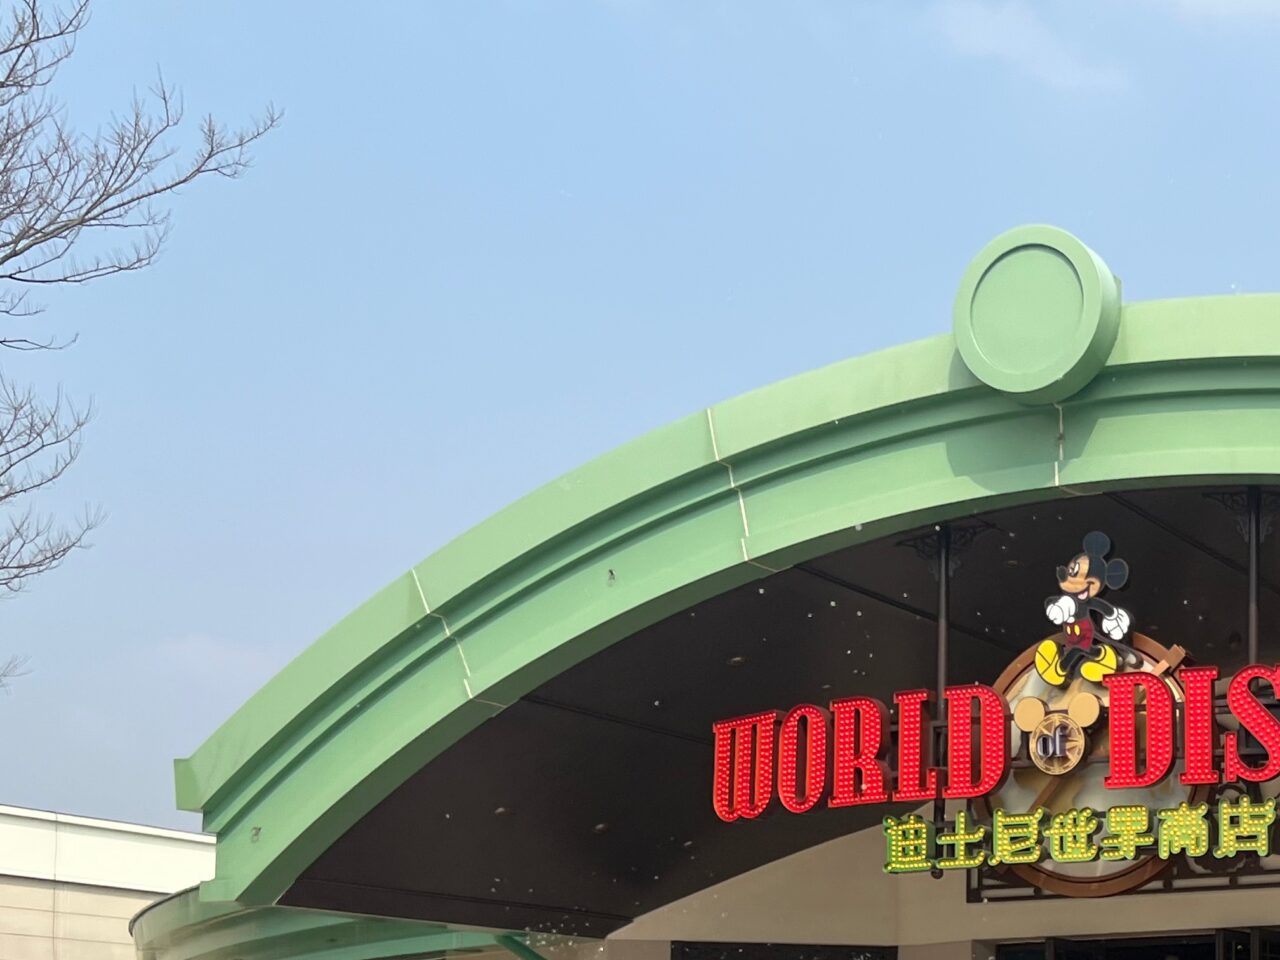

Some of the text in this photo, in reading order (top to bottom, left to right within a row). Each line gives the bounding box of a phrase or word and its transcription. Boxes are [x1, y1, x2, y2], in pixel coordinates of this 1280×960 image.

[712, 684, 1010, 823] WORLD
[1037, 721, 1068, 758] of
[882, 796, 1278, 874] 迪士尼世界商店
